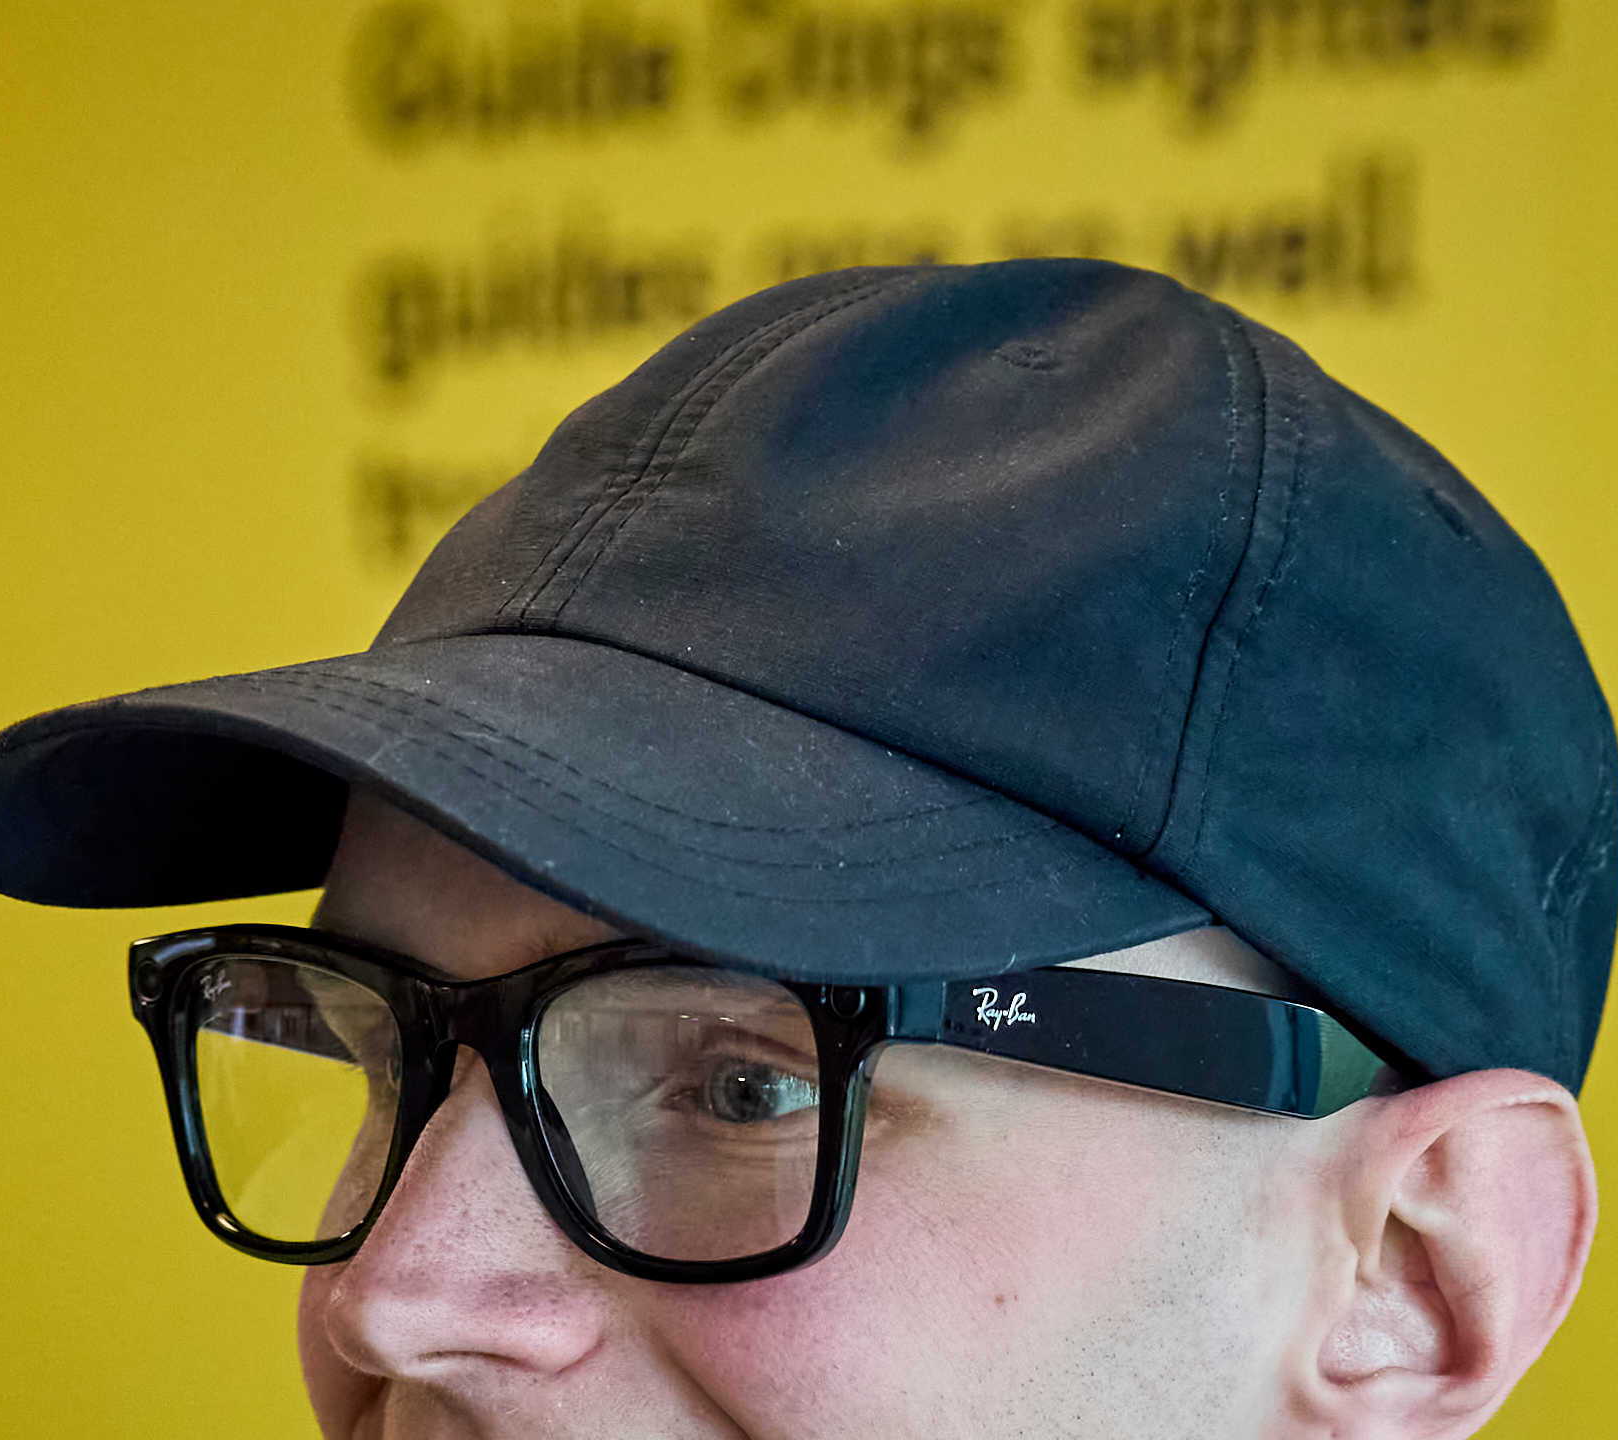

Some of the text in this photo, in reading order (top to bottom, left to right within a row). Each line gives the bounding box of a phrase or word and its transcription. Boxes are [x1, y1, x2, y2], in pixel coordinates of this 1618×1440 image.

[354, 0, 682, 148] Guide
[712, 0, 1017, 155] Dogs
[359, 203, 708, 390] guides
